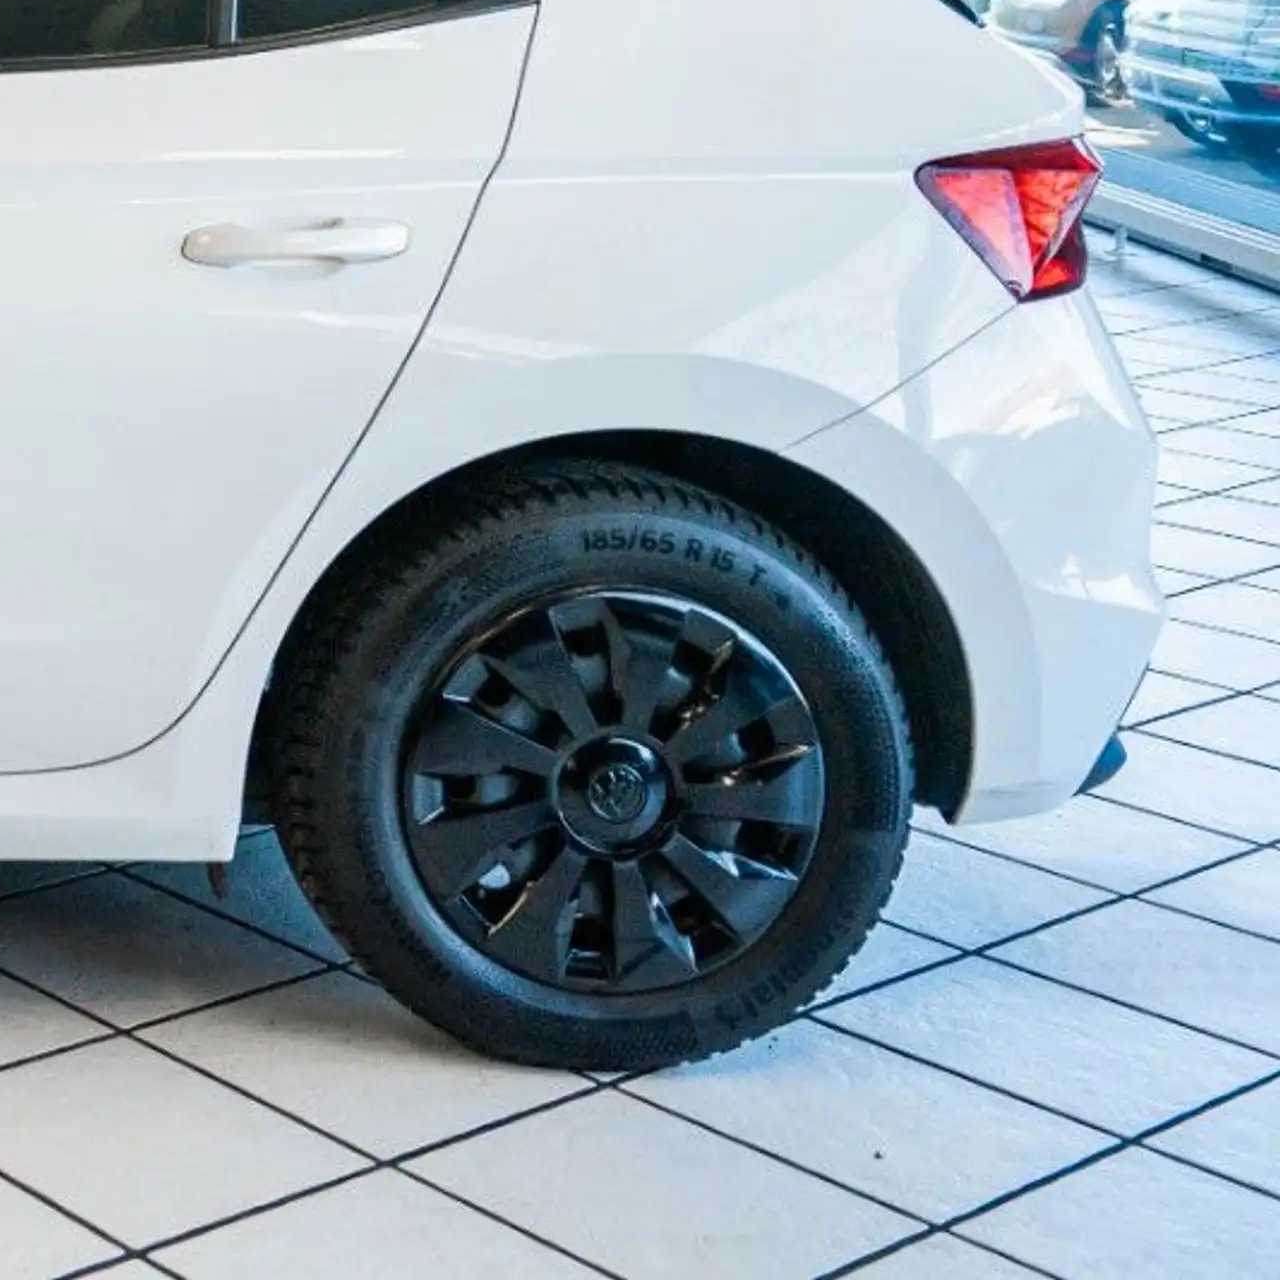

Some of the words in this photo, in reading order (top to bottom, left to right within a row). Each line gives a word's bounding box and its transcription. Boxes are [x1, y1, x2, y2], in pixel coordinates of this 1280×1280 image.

[581, 525, 675, 554] 185/65
[684, 538, 703, 562] R
[710, 547, 736, 571] 15
[748, 563, 767, 586] T
